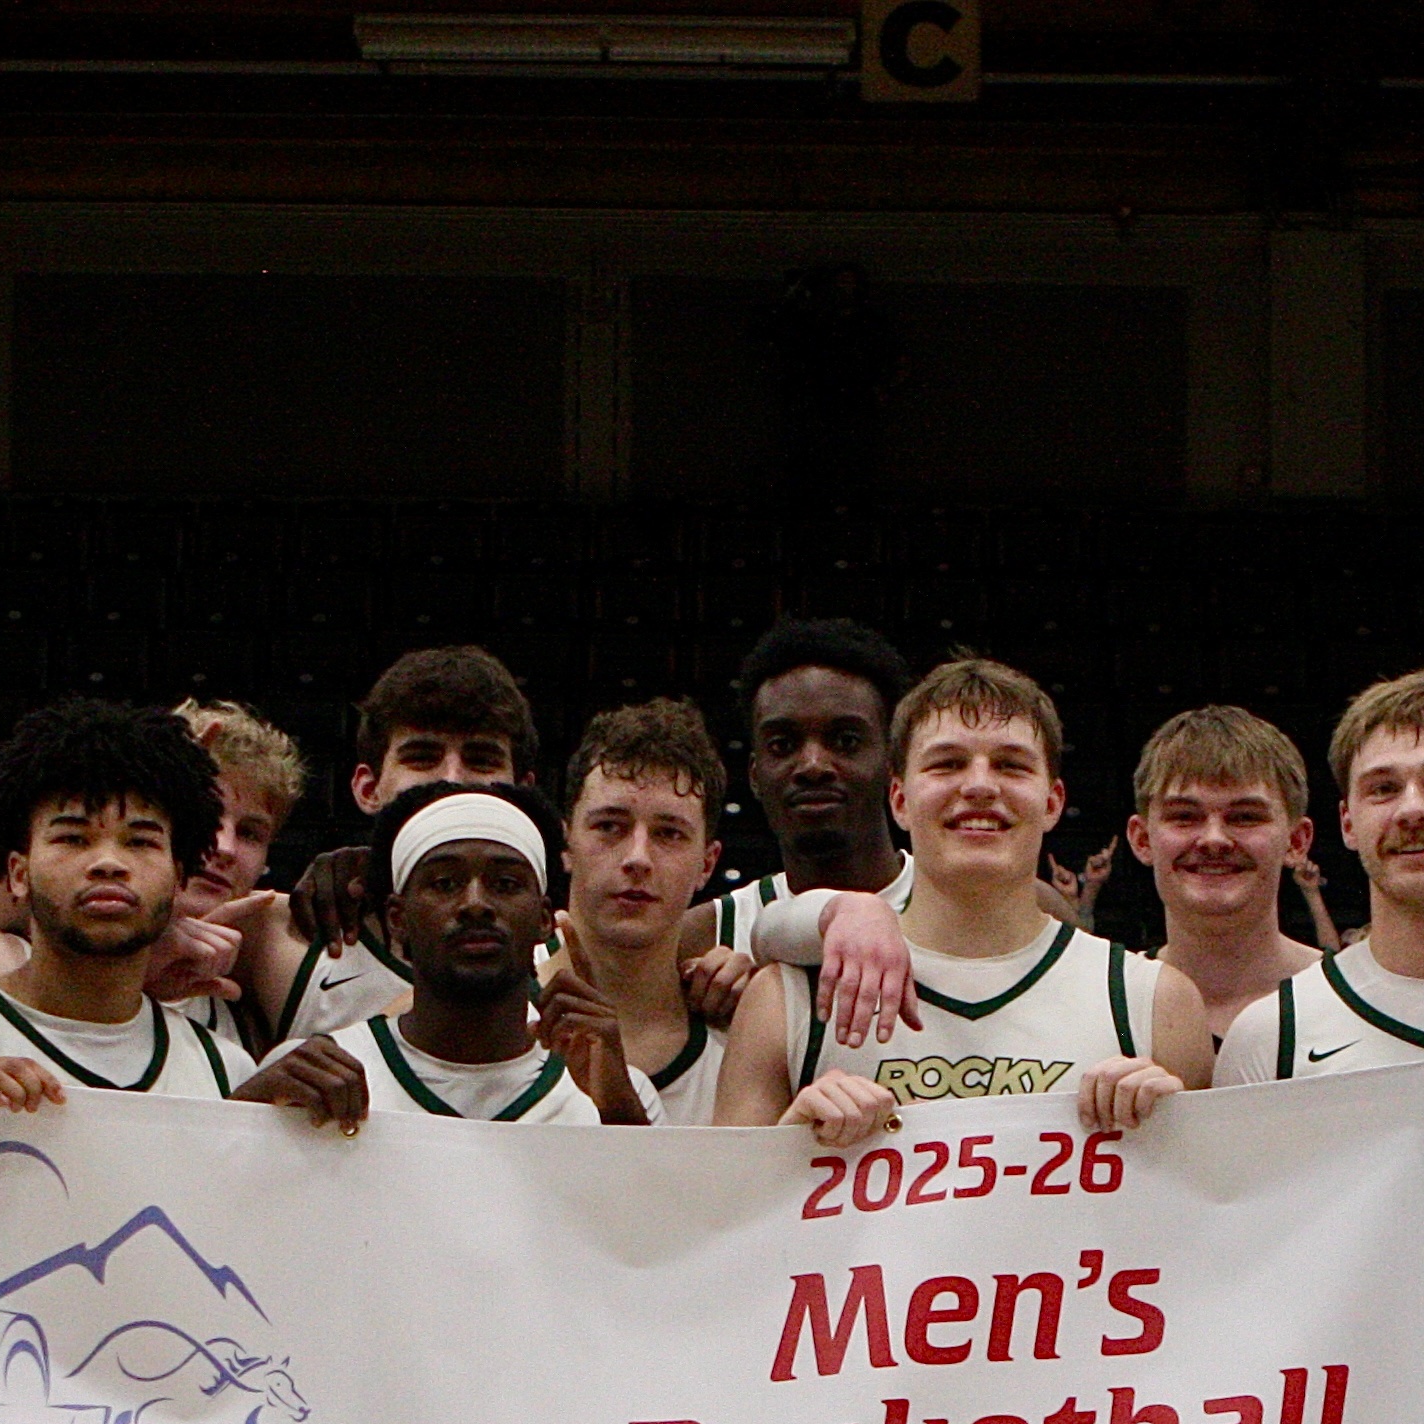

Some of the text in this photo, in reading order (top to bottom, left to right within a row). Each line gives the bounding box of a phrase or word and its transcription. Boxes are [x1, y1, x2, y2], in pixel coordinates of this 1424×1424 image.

[879, 0, 962, 87] C
[876, 1055, 1075, 1106] ROCKY
[802, 1130, 1123, 1220] 2025-26
[770, 1249, 1166, 1383] Men's
